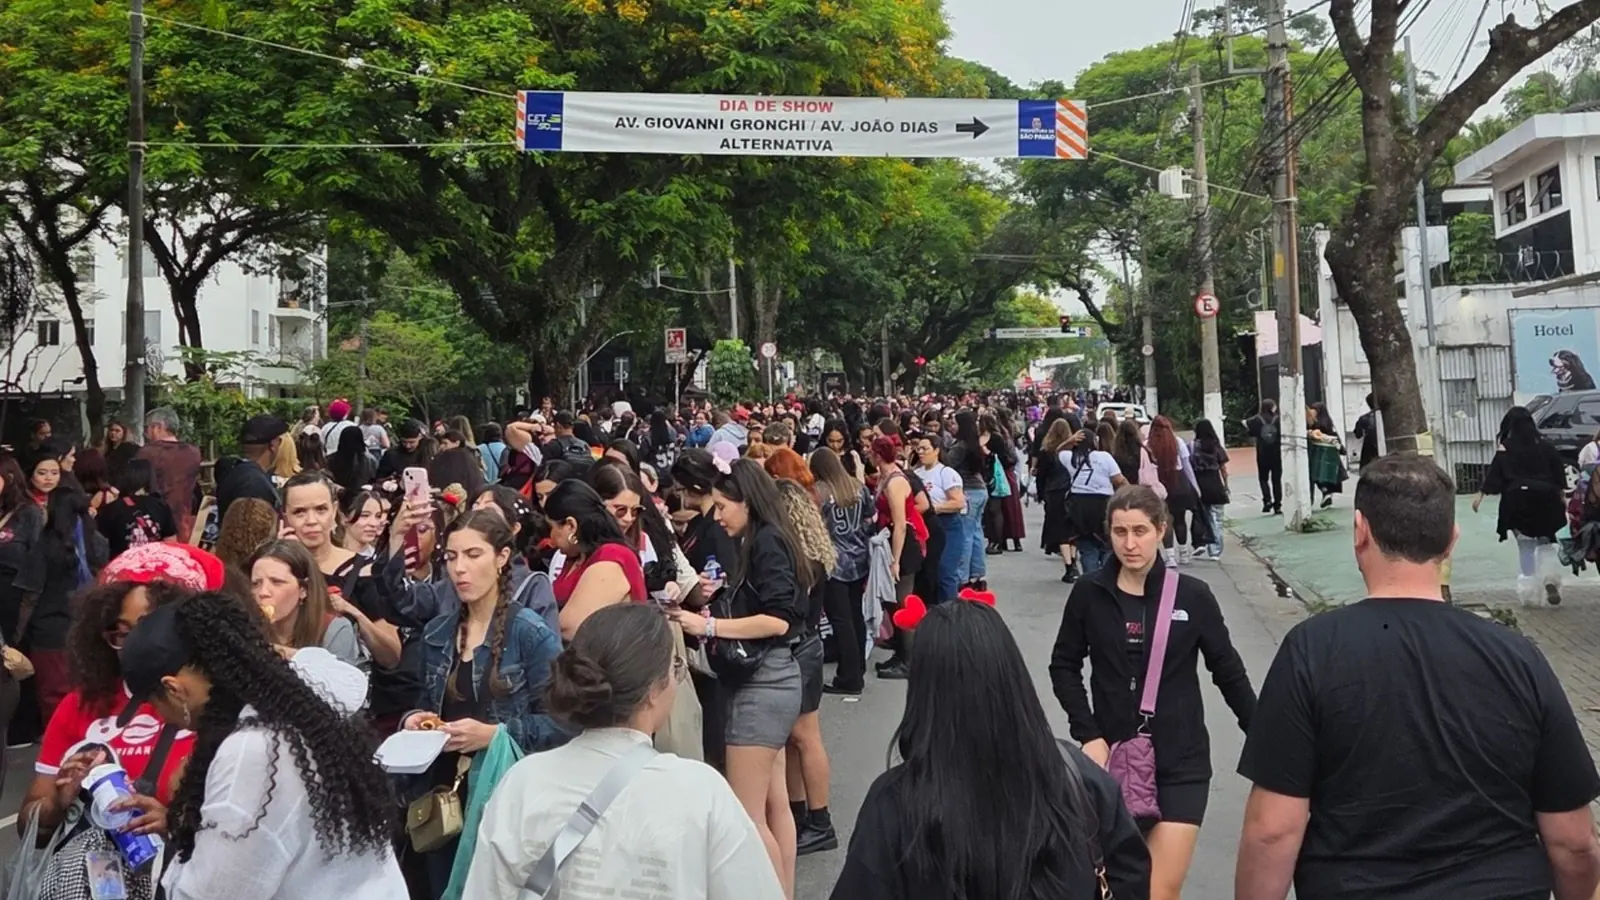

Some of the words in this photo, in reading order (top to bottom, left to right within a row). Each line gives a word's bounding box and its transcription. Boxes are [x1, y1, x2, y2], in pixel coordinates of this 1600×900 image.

[719, 99, 748, 112] DIA
[754, 100, 777, 112] DE
[782, 100, 834, 113] SHOW
[614, 116, 640, 129] AV.
[644, 116, 724, 130] GIOVANNI
[730, 118, 806, 131] GRONCHI
[811, 120, 815, 132] /
[820, 120, 845, 132] AV.
[849, 118, 894, 133] JOÃO
[900, 121, 938, 133] DIAS
[719, 137, 833, 151] ALTERNATIVA
[1203, 298, 1213, 311] E
[1534, 323, 1574, 337] Hotel
